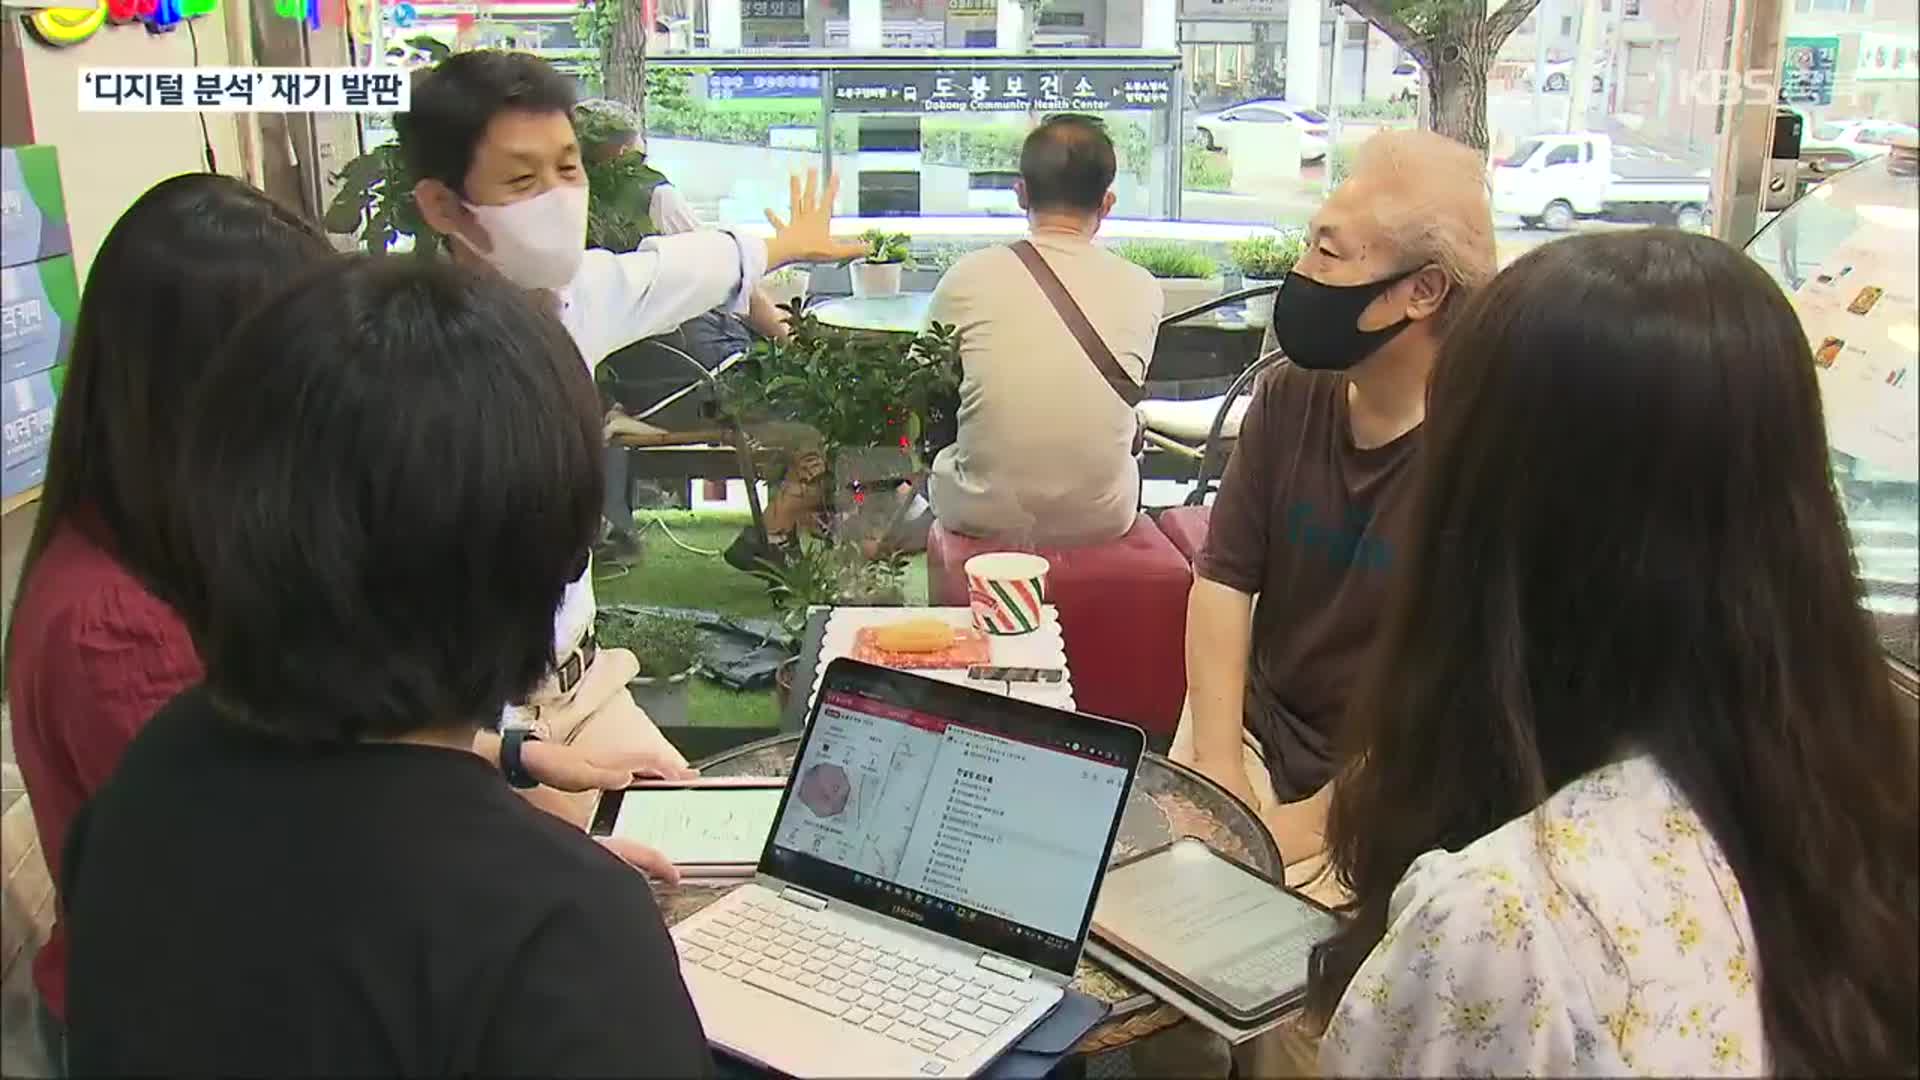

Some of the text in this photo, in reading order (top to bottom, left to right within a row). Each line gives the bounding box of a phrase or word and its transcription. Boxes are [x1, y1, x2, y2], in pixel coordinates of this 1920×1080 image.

[931, 75, 1096, 100] 도봉보건소
[924, 100, 1110, 112] Dobong Community Health Center
